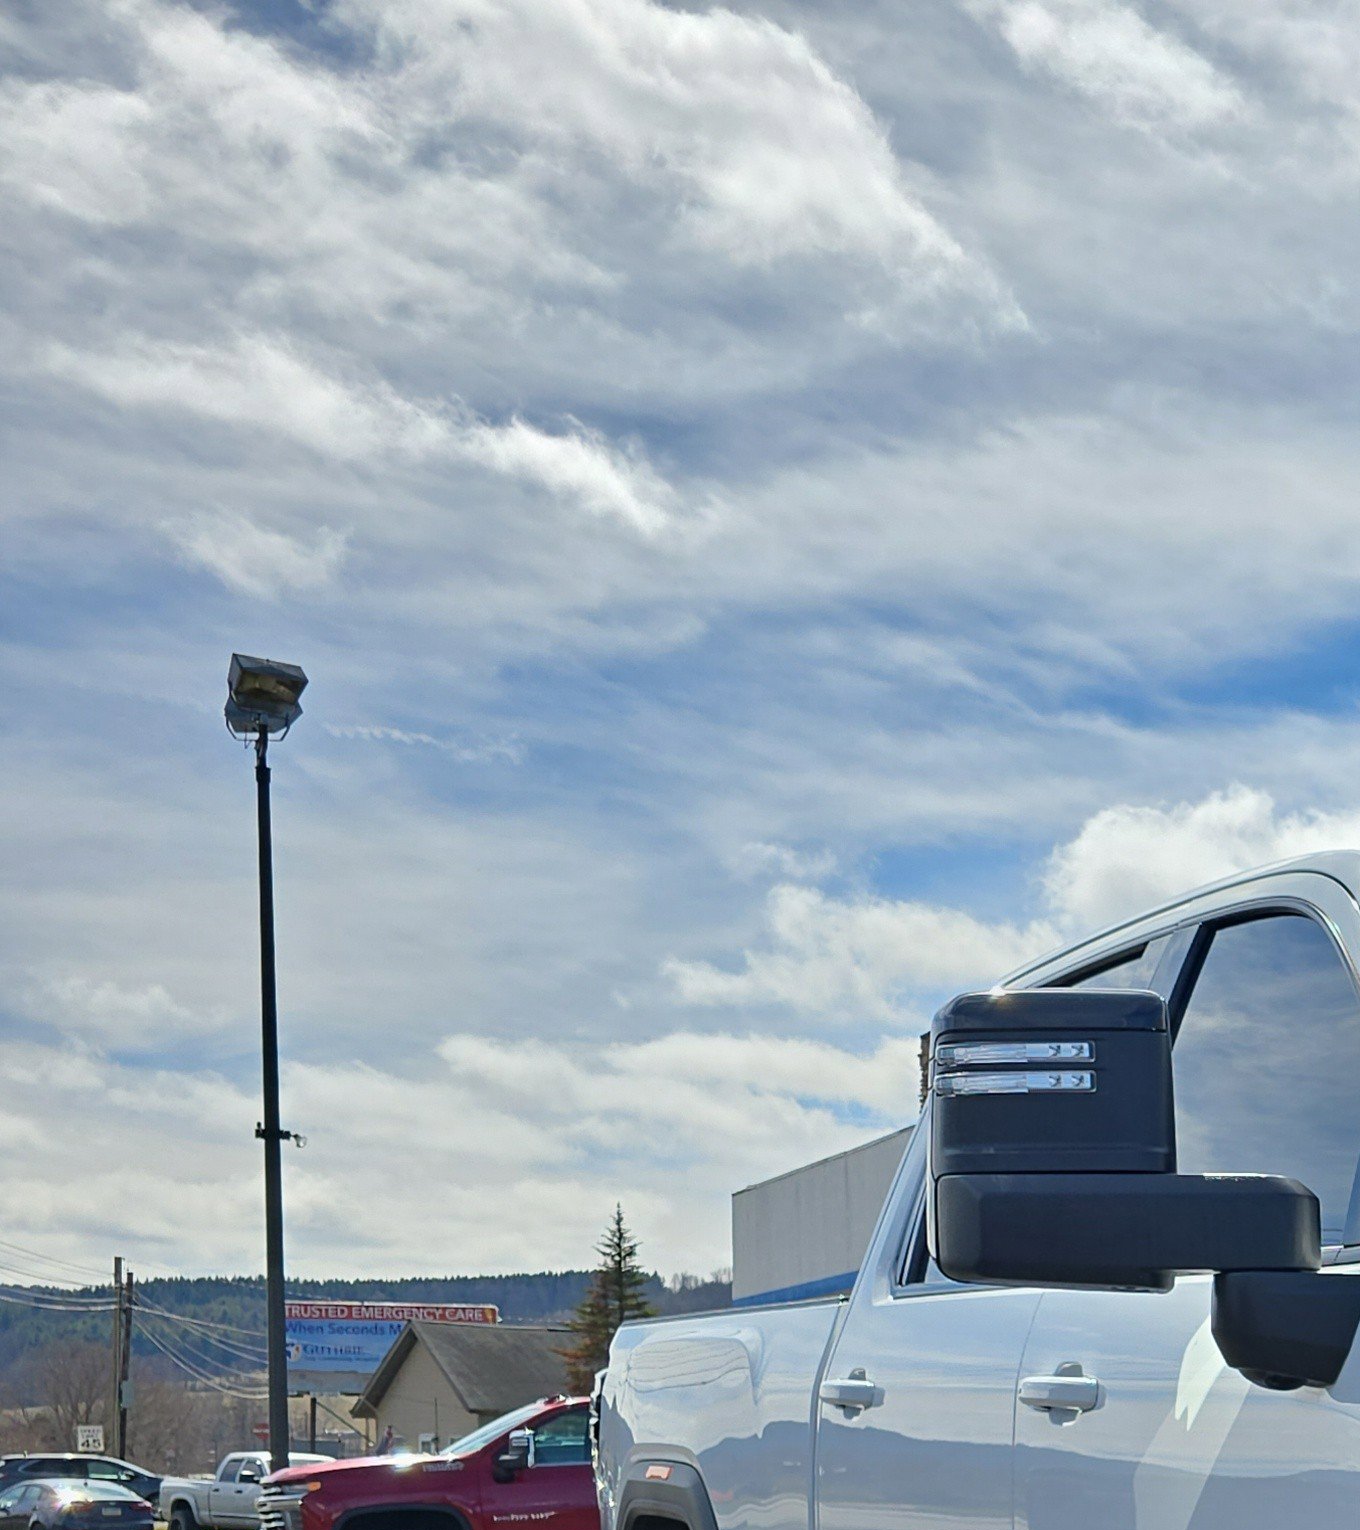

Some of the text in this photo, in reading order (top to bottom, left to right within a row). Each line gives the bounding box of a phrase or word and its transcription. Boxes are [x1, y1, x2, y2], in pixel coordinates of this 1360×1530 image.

[285, 1305, 484, 1322] TRUSTED EMERGENCY CARE
[285, 1322, 327, 1336] When
[328, 1322, 385, 1336] Seconds
